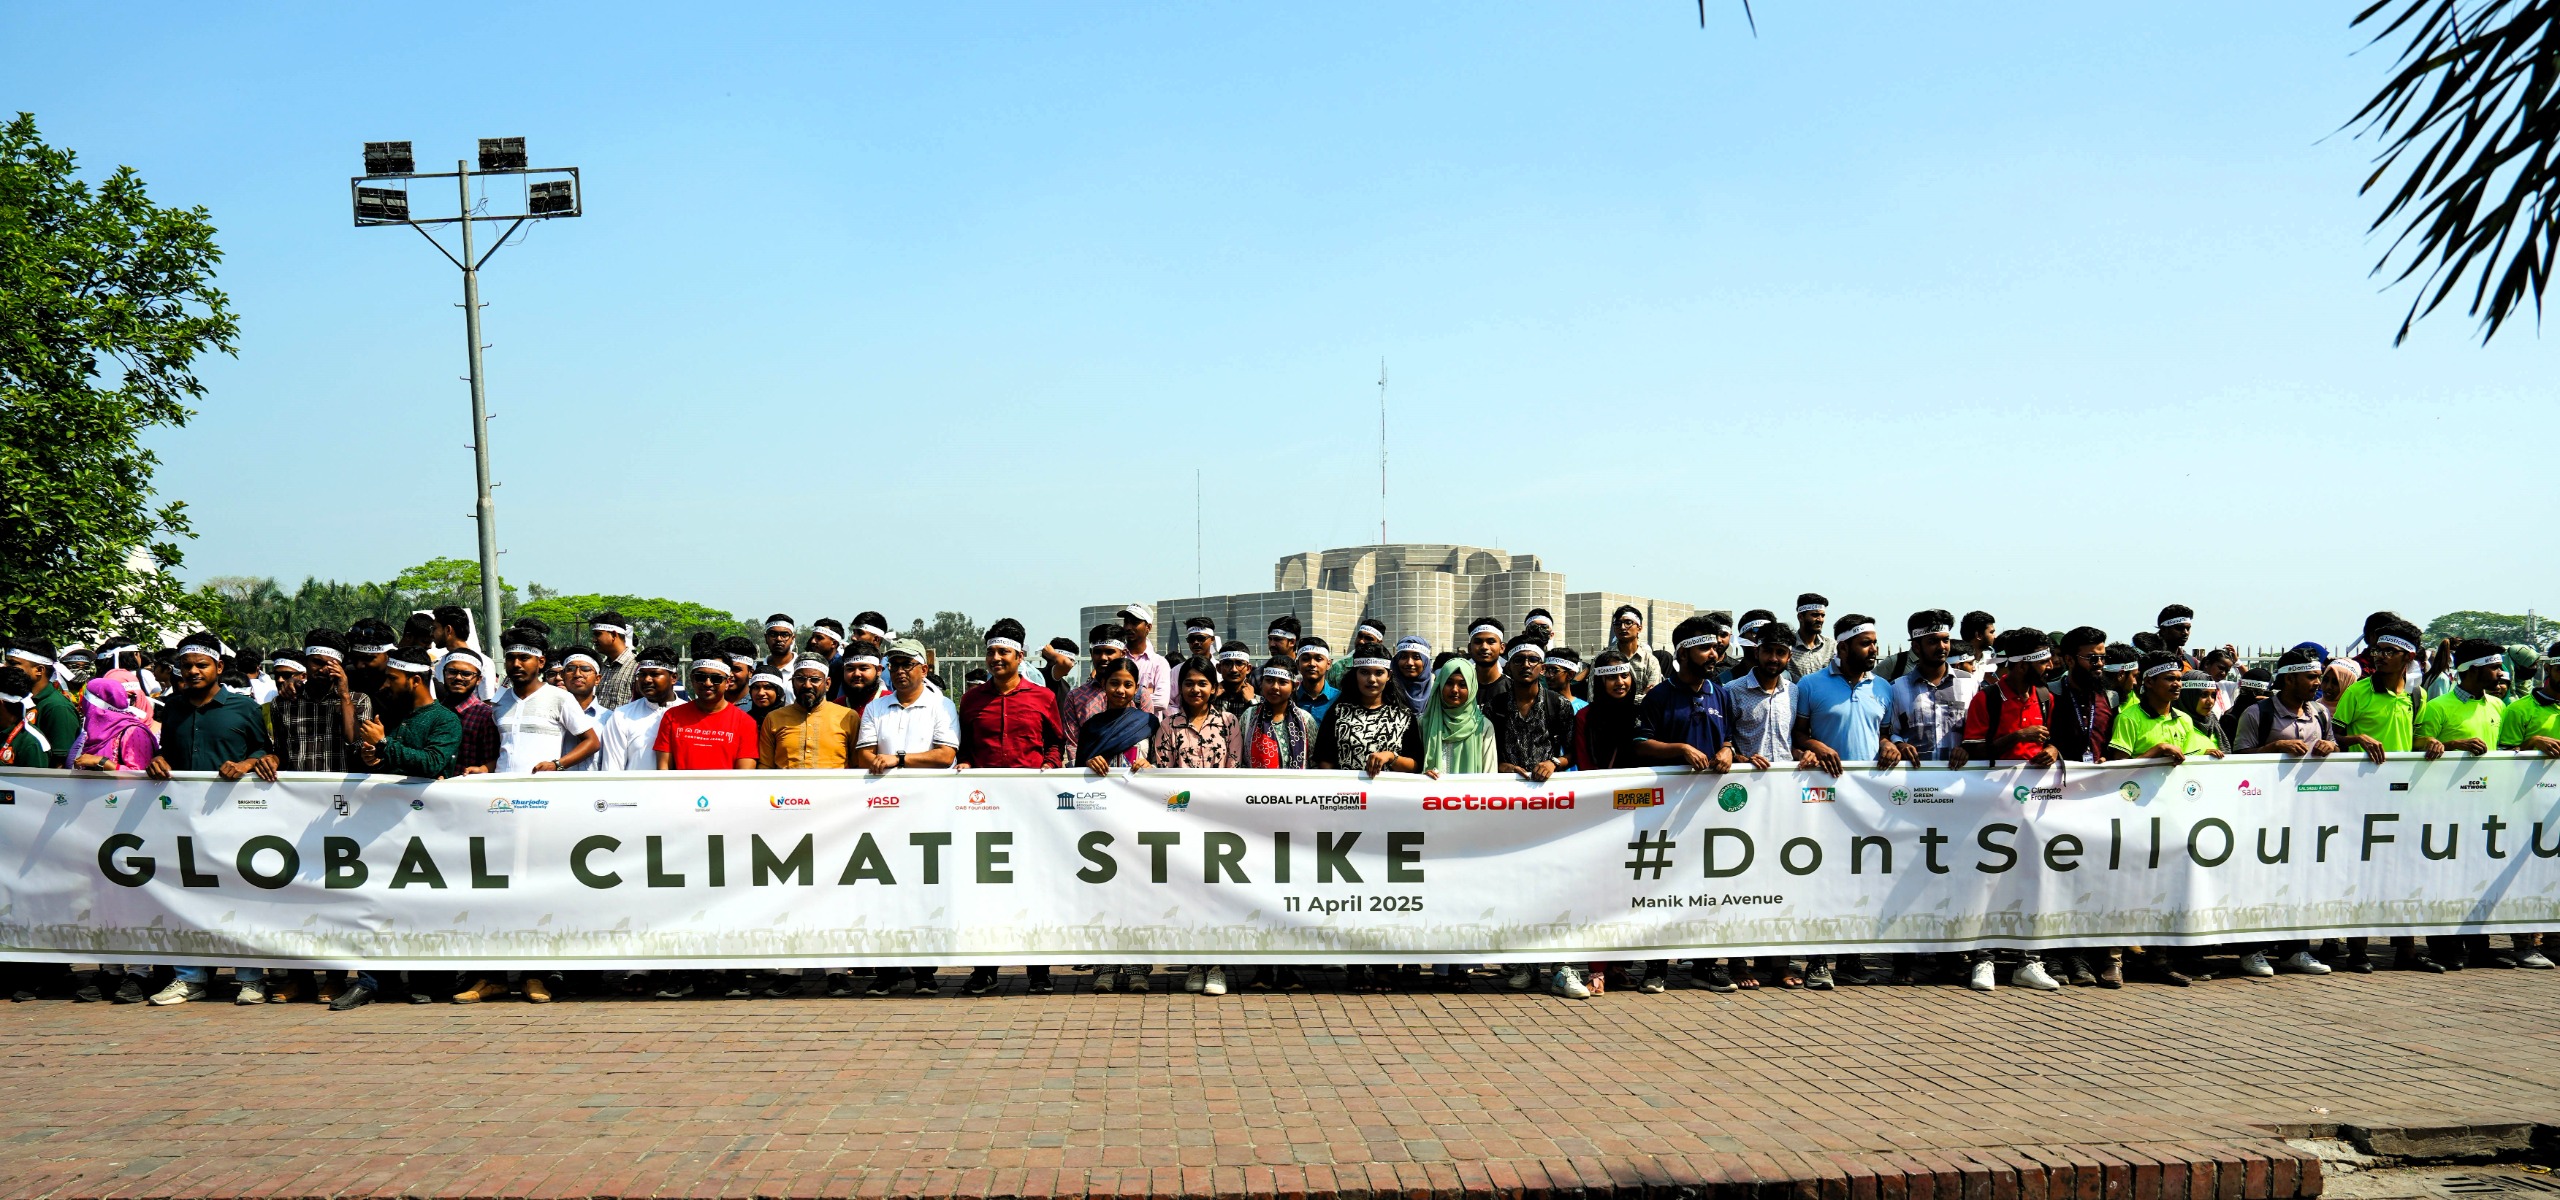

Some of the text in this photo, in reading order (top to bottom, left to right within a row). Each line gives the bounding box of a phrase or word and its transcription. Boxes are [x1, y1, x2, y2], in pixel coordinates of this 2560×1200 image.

[2242, 787, 2262, 796] sada
[1245, 795, 1360, 805] GLOBAL PLATFORM
[97, 830, 1425, 890] GLOBAL CLIMATE STRIKE
[1283, 895, 1424, 916] 11 April 2025
[1631, 894, 1784, 909] Manik Mia Avenue
